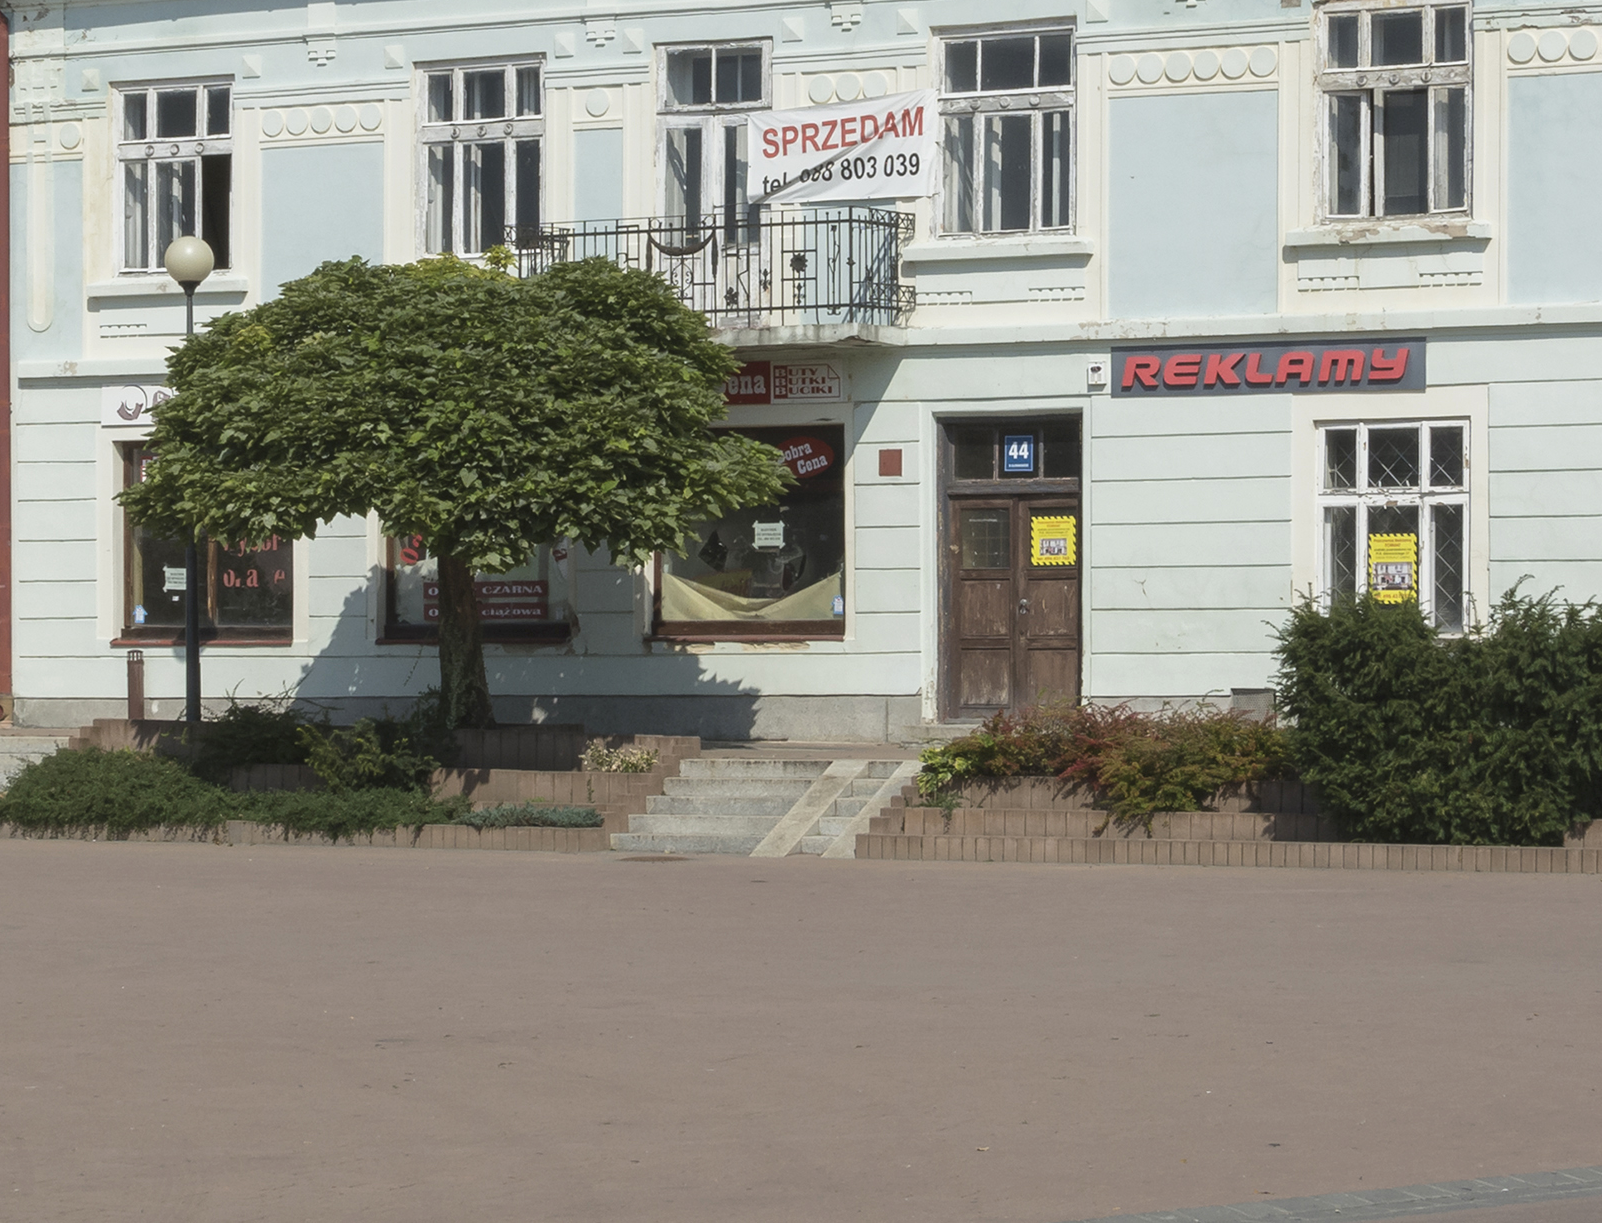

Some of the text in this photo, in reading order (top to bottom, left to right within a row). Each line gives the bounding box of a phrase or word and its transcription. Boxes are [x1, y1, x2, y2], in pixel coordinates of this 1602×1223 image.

[762, 106, 924, 159] SPRZEDAM
[841, 155, 877, 181] 803
[883, 152, 920, 178] 039
[1121, 347, 1410, 388] REKLAMY
[1008, 441, 1029, 459] 44
[797, 454, 829, 475] Cena
[481, 584, 543, 595] CZARNA
